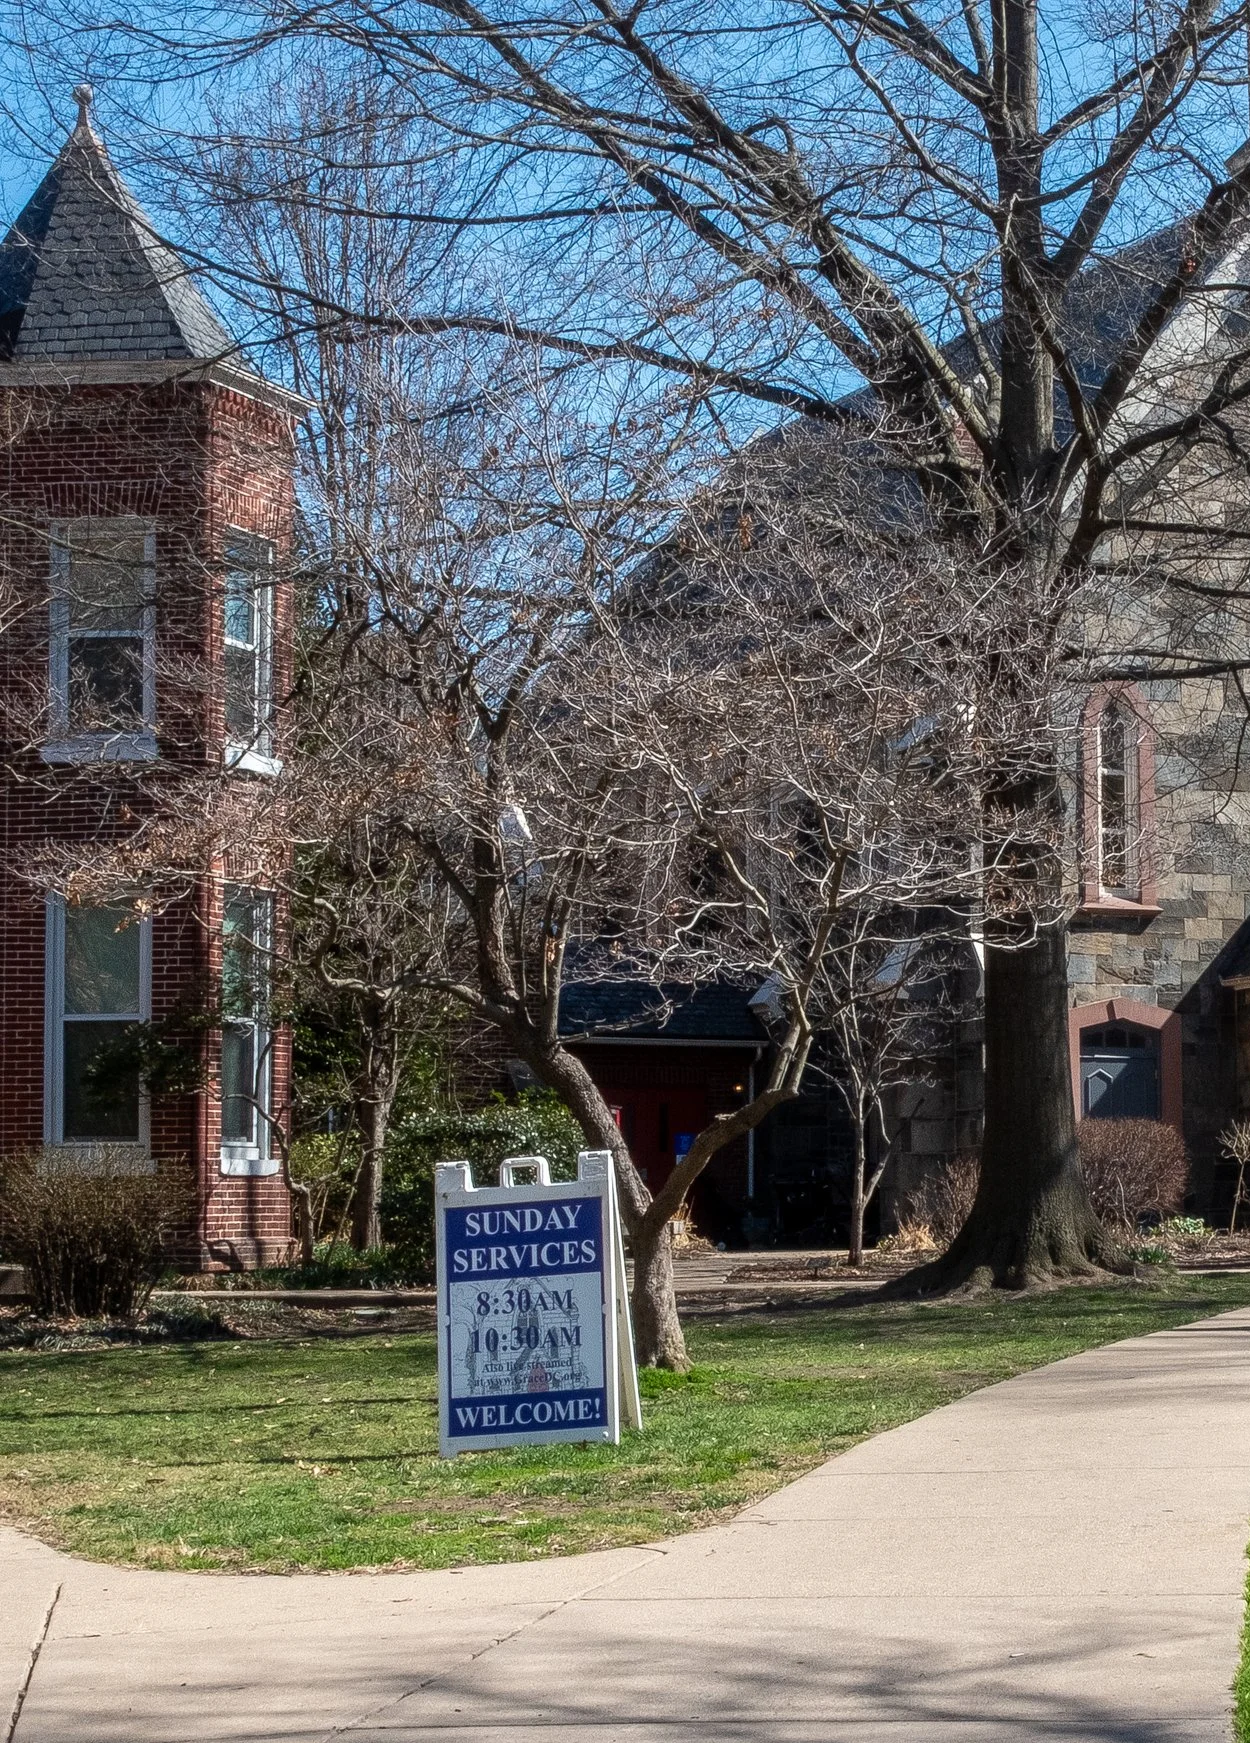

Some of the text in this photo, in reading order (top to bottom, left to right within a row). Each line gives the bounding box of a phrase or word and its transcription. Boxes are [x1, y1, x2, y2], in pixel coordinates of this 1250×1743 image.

[465, 1204, 582, 1237] SUNDAY
[453, 1239, 596, 1273] SERVICES
[477, 1288, 573, 1316] 8:30AM
[471, 1325, 582, 1354] 10:30AM
[482, 1357, 572, 1374] Also live streamed
[486, 1371, 583, 1387] www.GraceDC.org
[455, 1397, 601, 1429] WELCOME!
